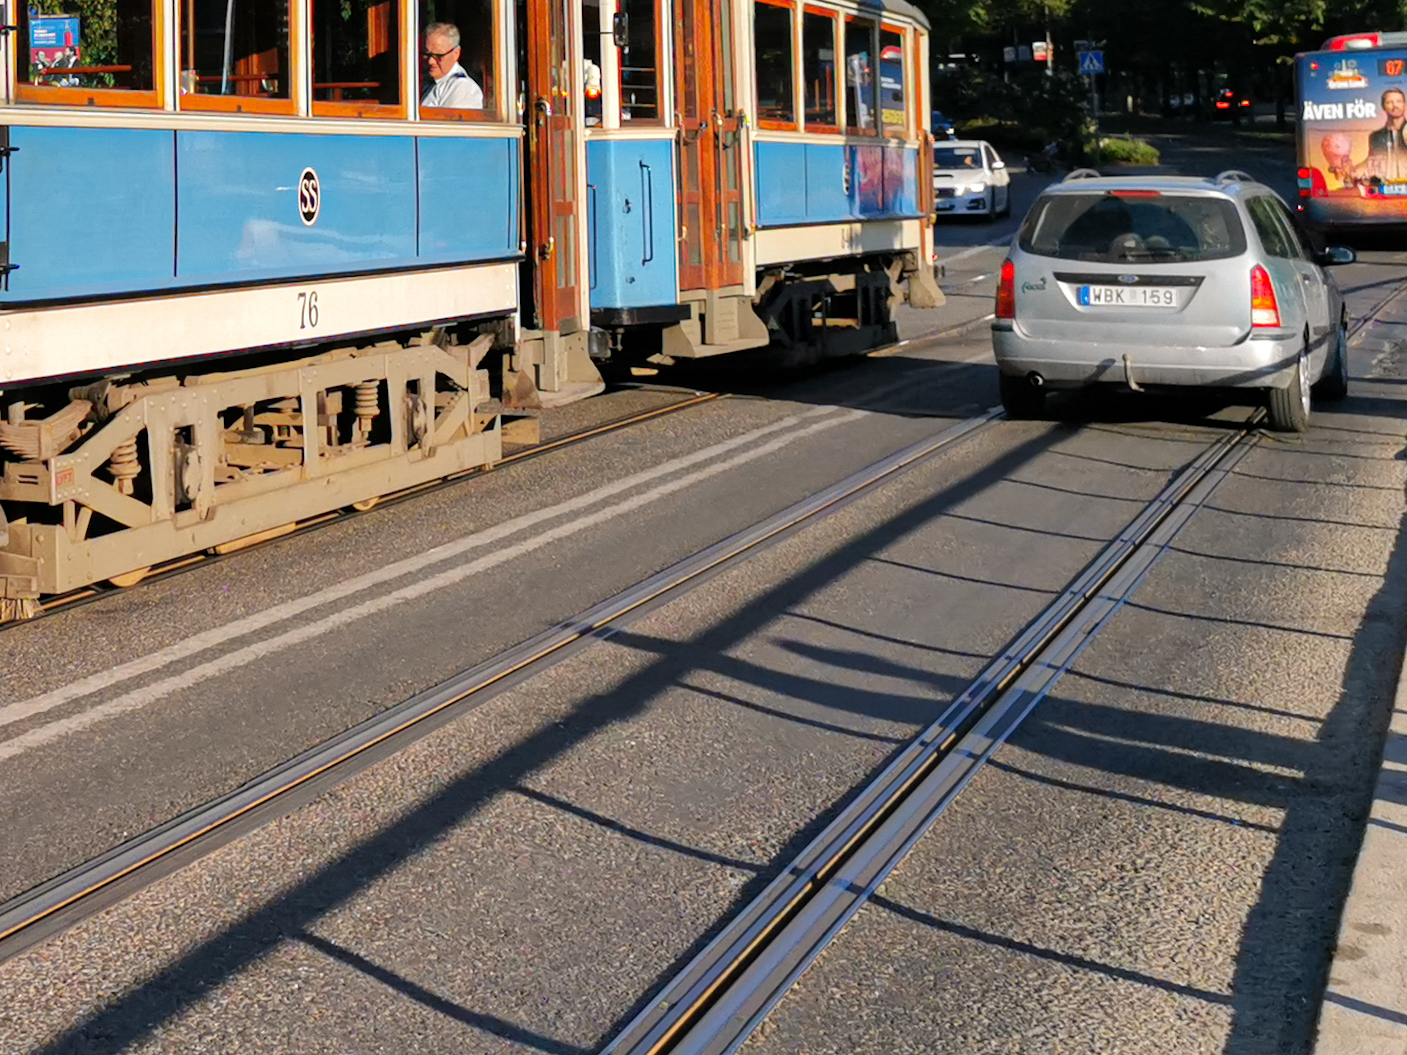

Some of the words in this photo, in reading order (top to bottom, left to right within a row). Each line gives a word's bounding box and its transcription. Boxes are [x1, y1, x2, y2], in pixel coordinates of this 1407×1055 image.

[1303, 101, 1344, 120] ÄVEN
[1346, 99, 1377, 119] FÖR
[1093, 288, 1125, 303] WBK
[1141, 290, 1173, 304] 159
[298, 291, 319, 330] 76
